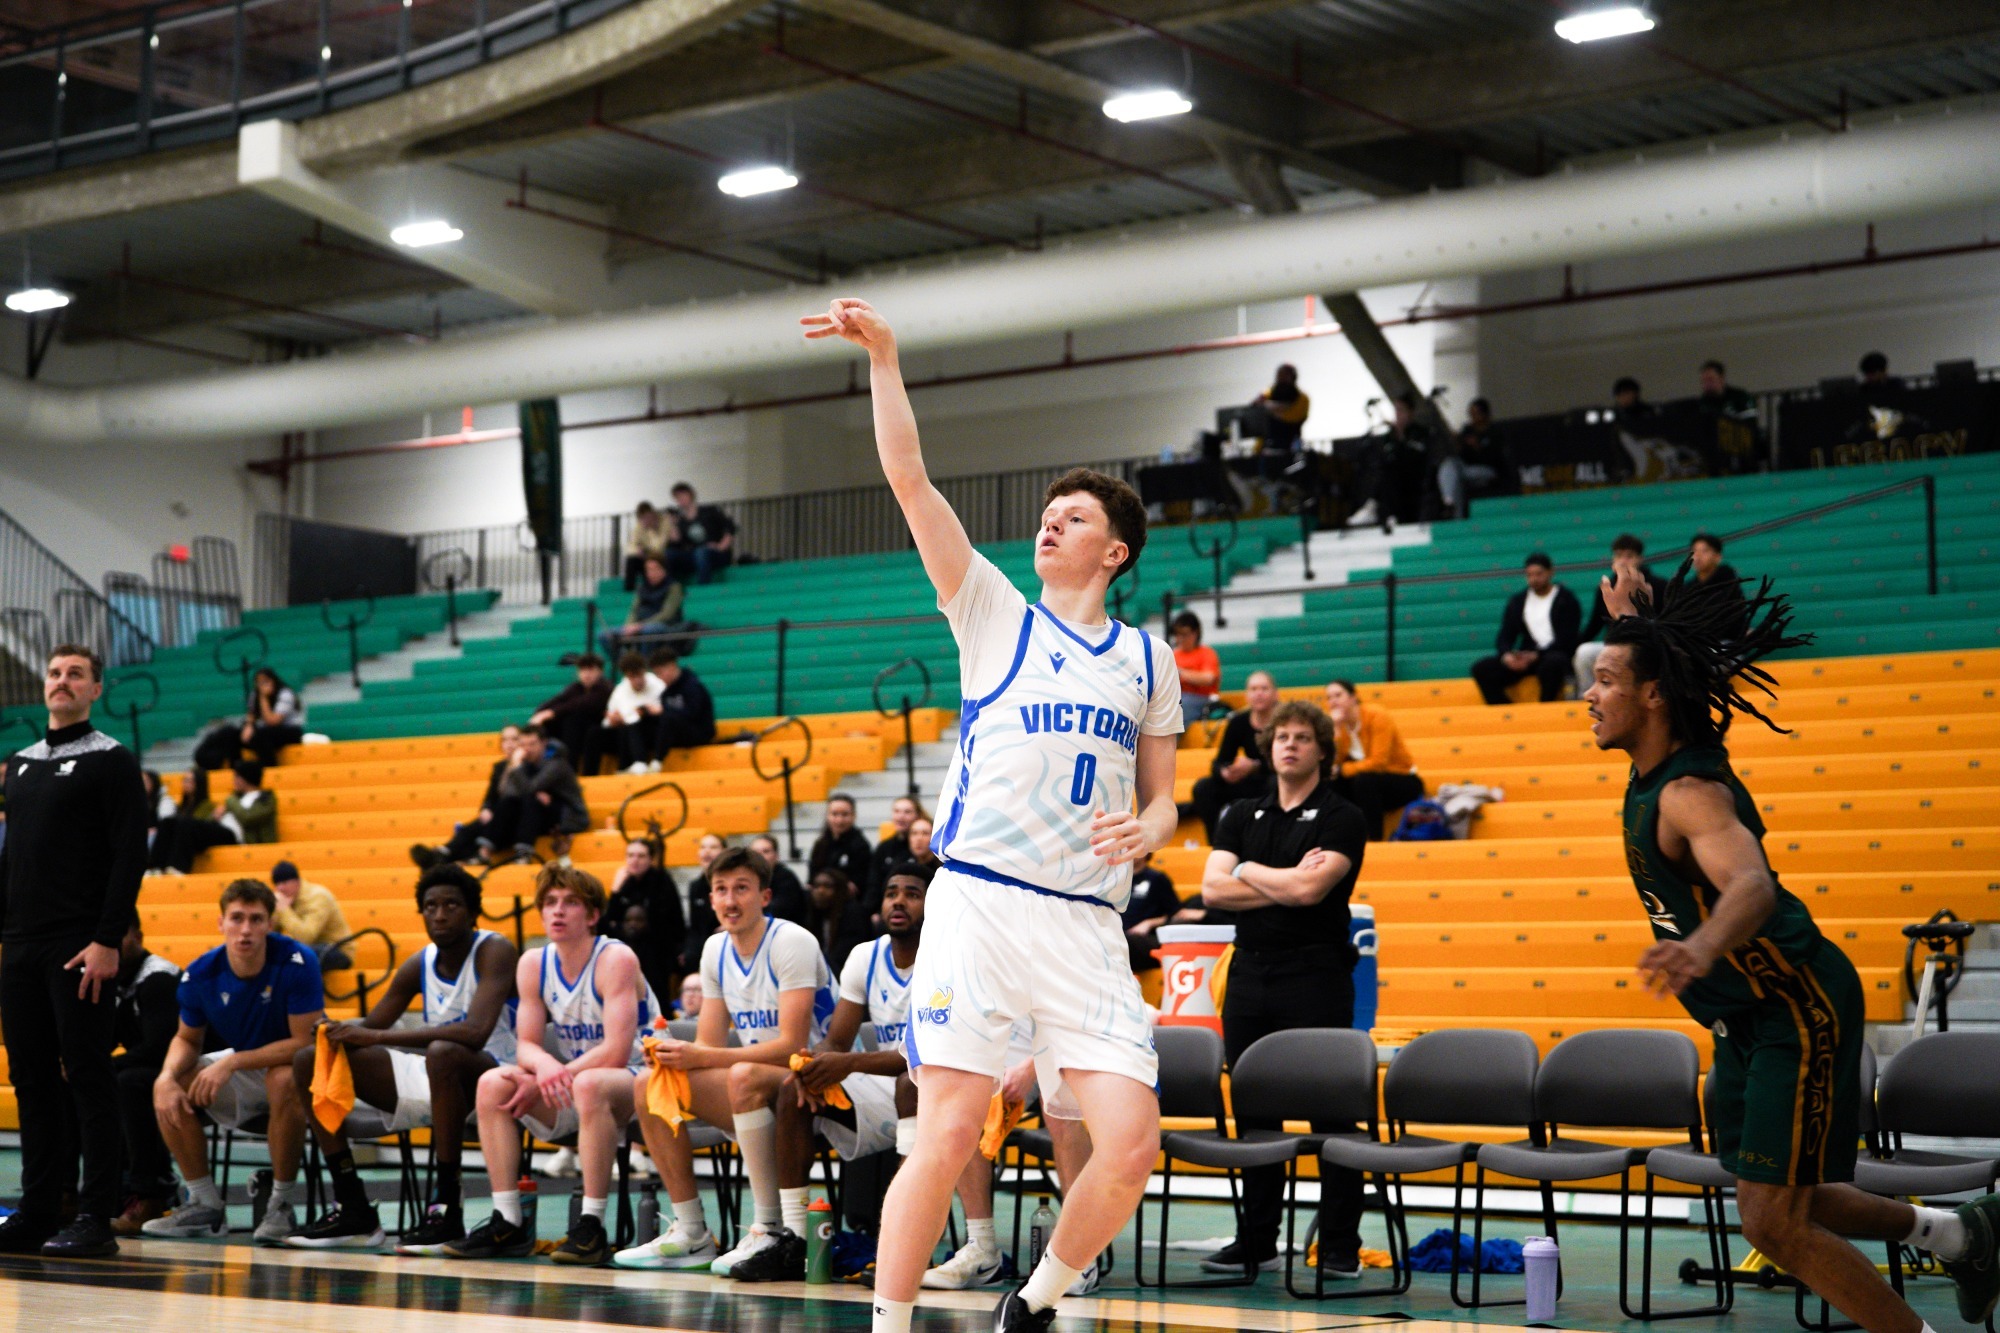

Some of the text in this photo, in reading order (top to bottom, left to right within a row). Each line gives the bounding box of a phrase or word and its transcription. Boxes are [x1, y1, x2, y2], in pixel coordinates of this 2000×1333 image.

[1020, 703, 1139, 756] VICTORIA
[1070, 753, 1097, 806] 0
[1171, 961, 1195, 994] G
